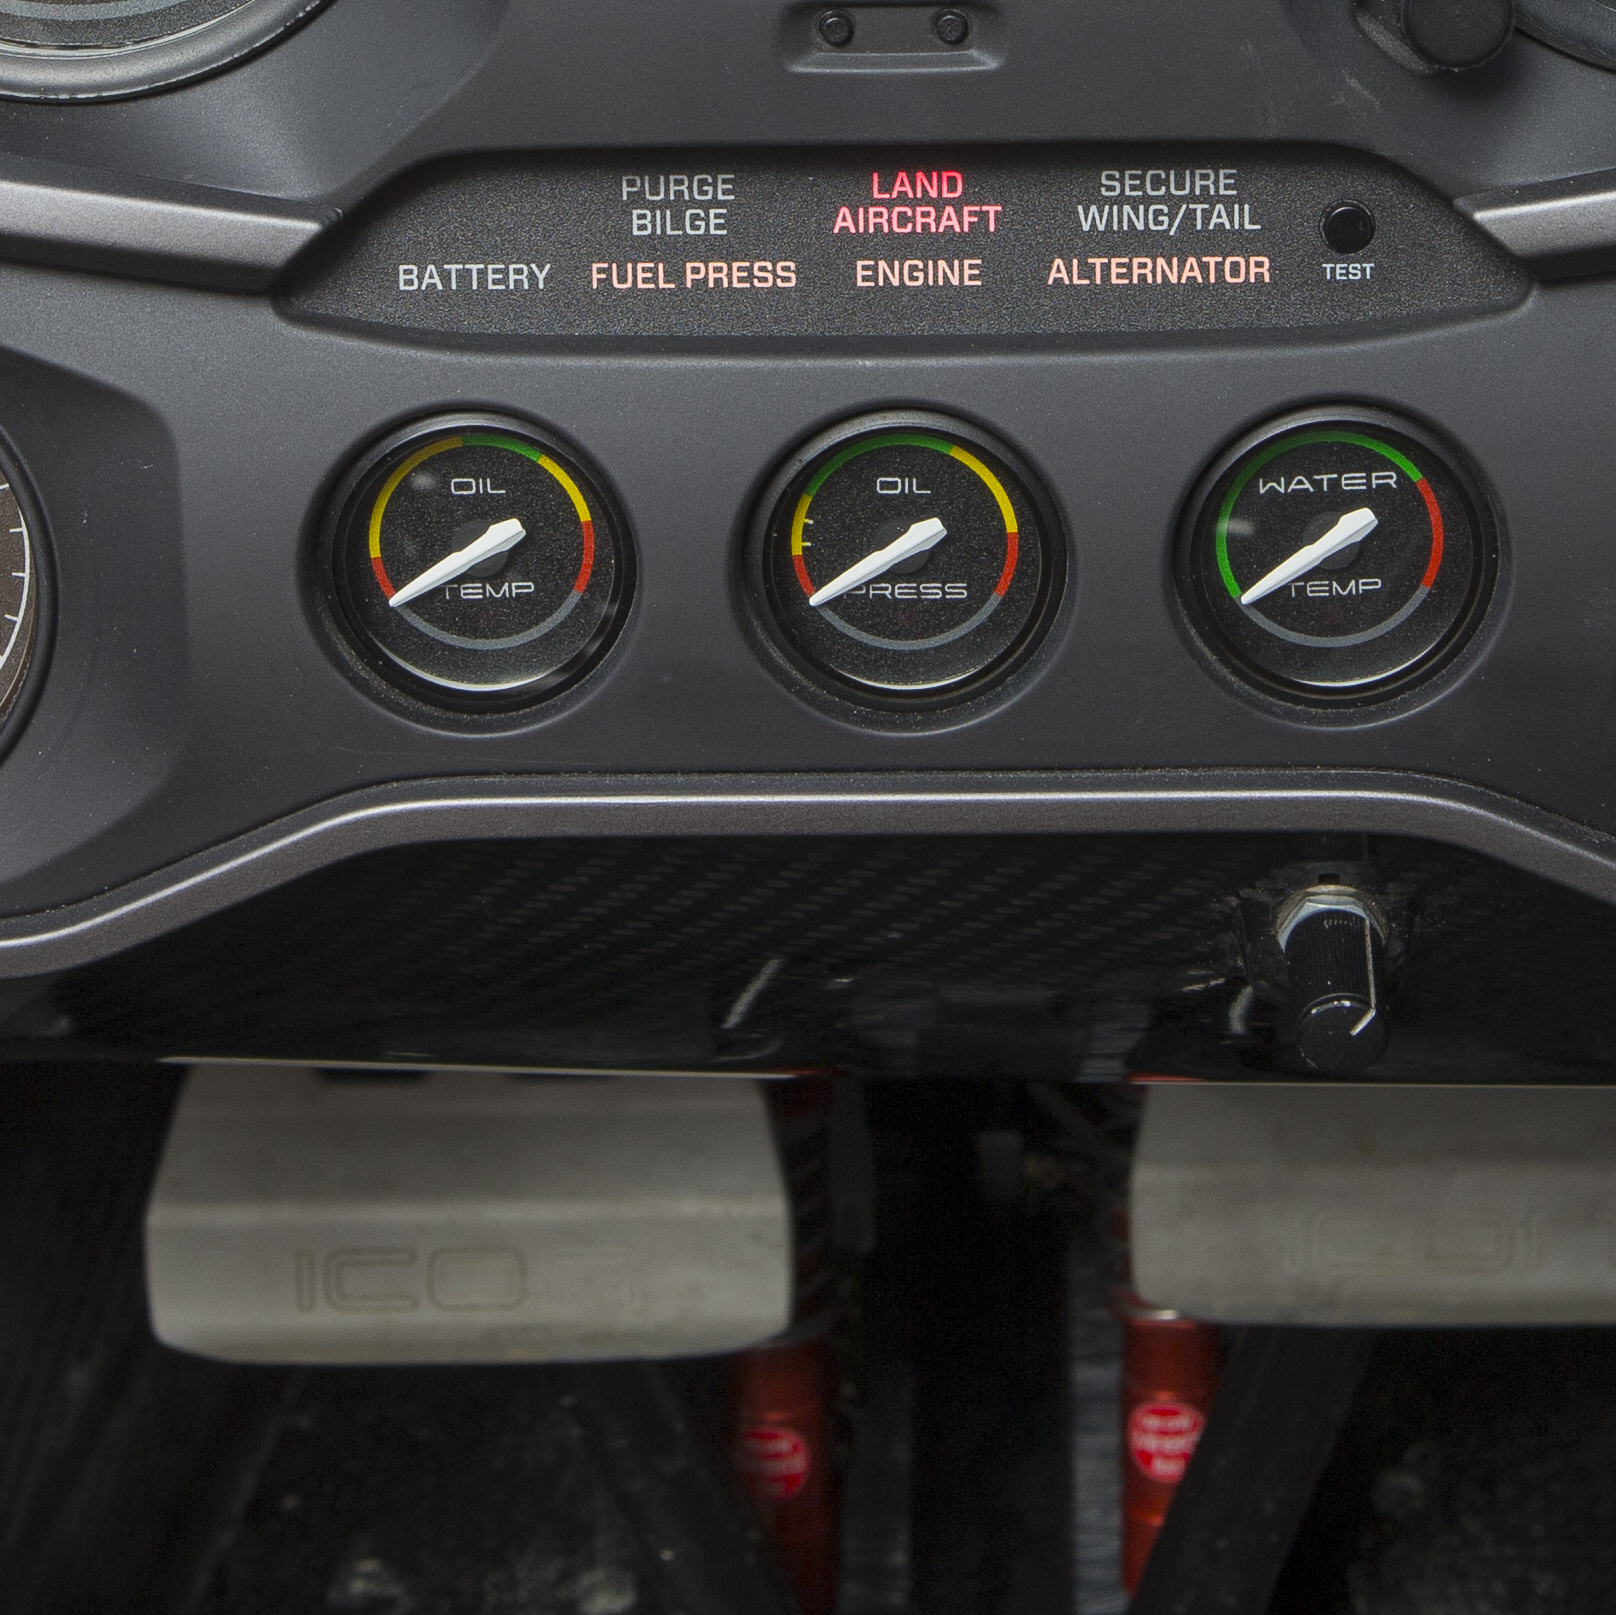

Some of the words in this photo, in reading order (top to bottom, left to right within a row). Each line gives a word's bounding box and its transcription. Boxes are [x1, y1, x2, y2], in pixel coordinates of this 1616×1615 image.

[621, 173, 736, 202] PURGE
[871, 170, 964, 199] LAND
[1099, 168, 1238, 197] SECURE
[631, 208, 729, 237] BILGE
[832, 204, 1003, 235] AIRCRAFT
[1077, 202, 1262, 236] WING/TAIL
[397, 263, 552, 292] BATTERY
[591, 261, 677, 290] FUEL
[685, 260, 797, 289] PRESS
[855, 259, 984, 288] ENGINE
[1046, 255, 1271, 286] ALTERNATOR
[1321, 262, 1376, 281] TEST
[450, 477, 507, 495] OIL
[876, 477, 931, 495] OIL
[1258, 471, 1398, 495] WATER
[437, 581, 535, 600] TEMP
[843, 583, 968, 600] PRESS
[1286, 578, 1382, 599] TEMP
[294, 1245, 635, 1313] ICO
